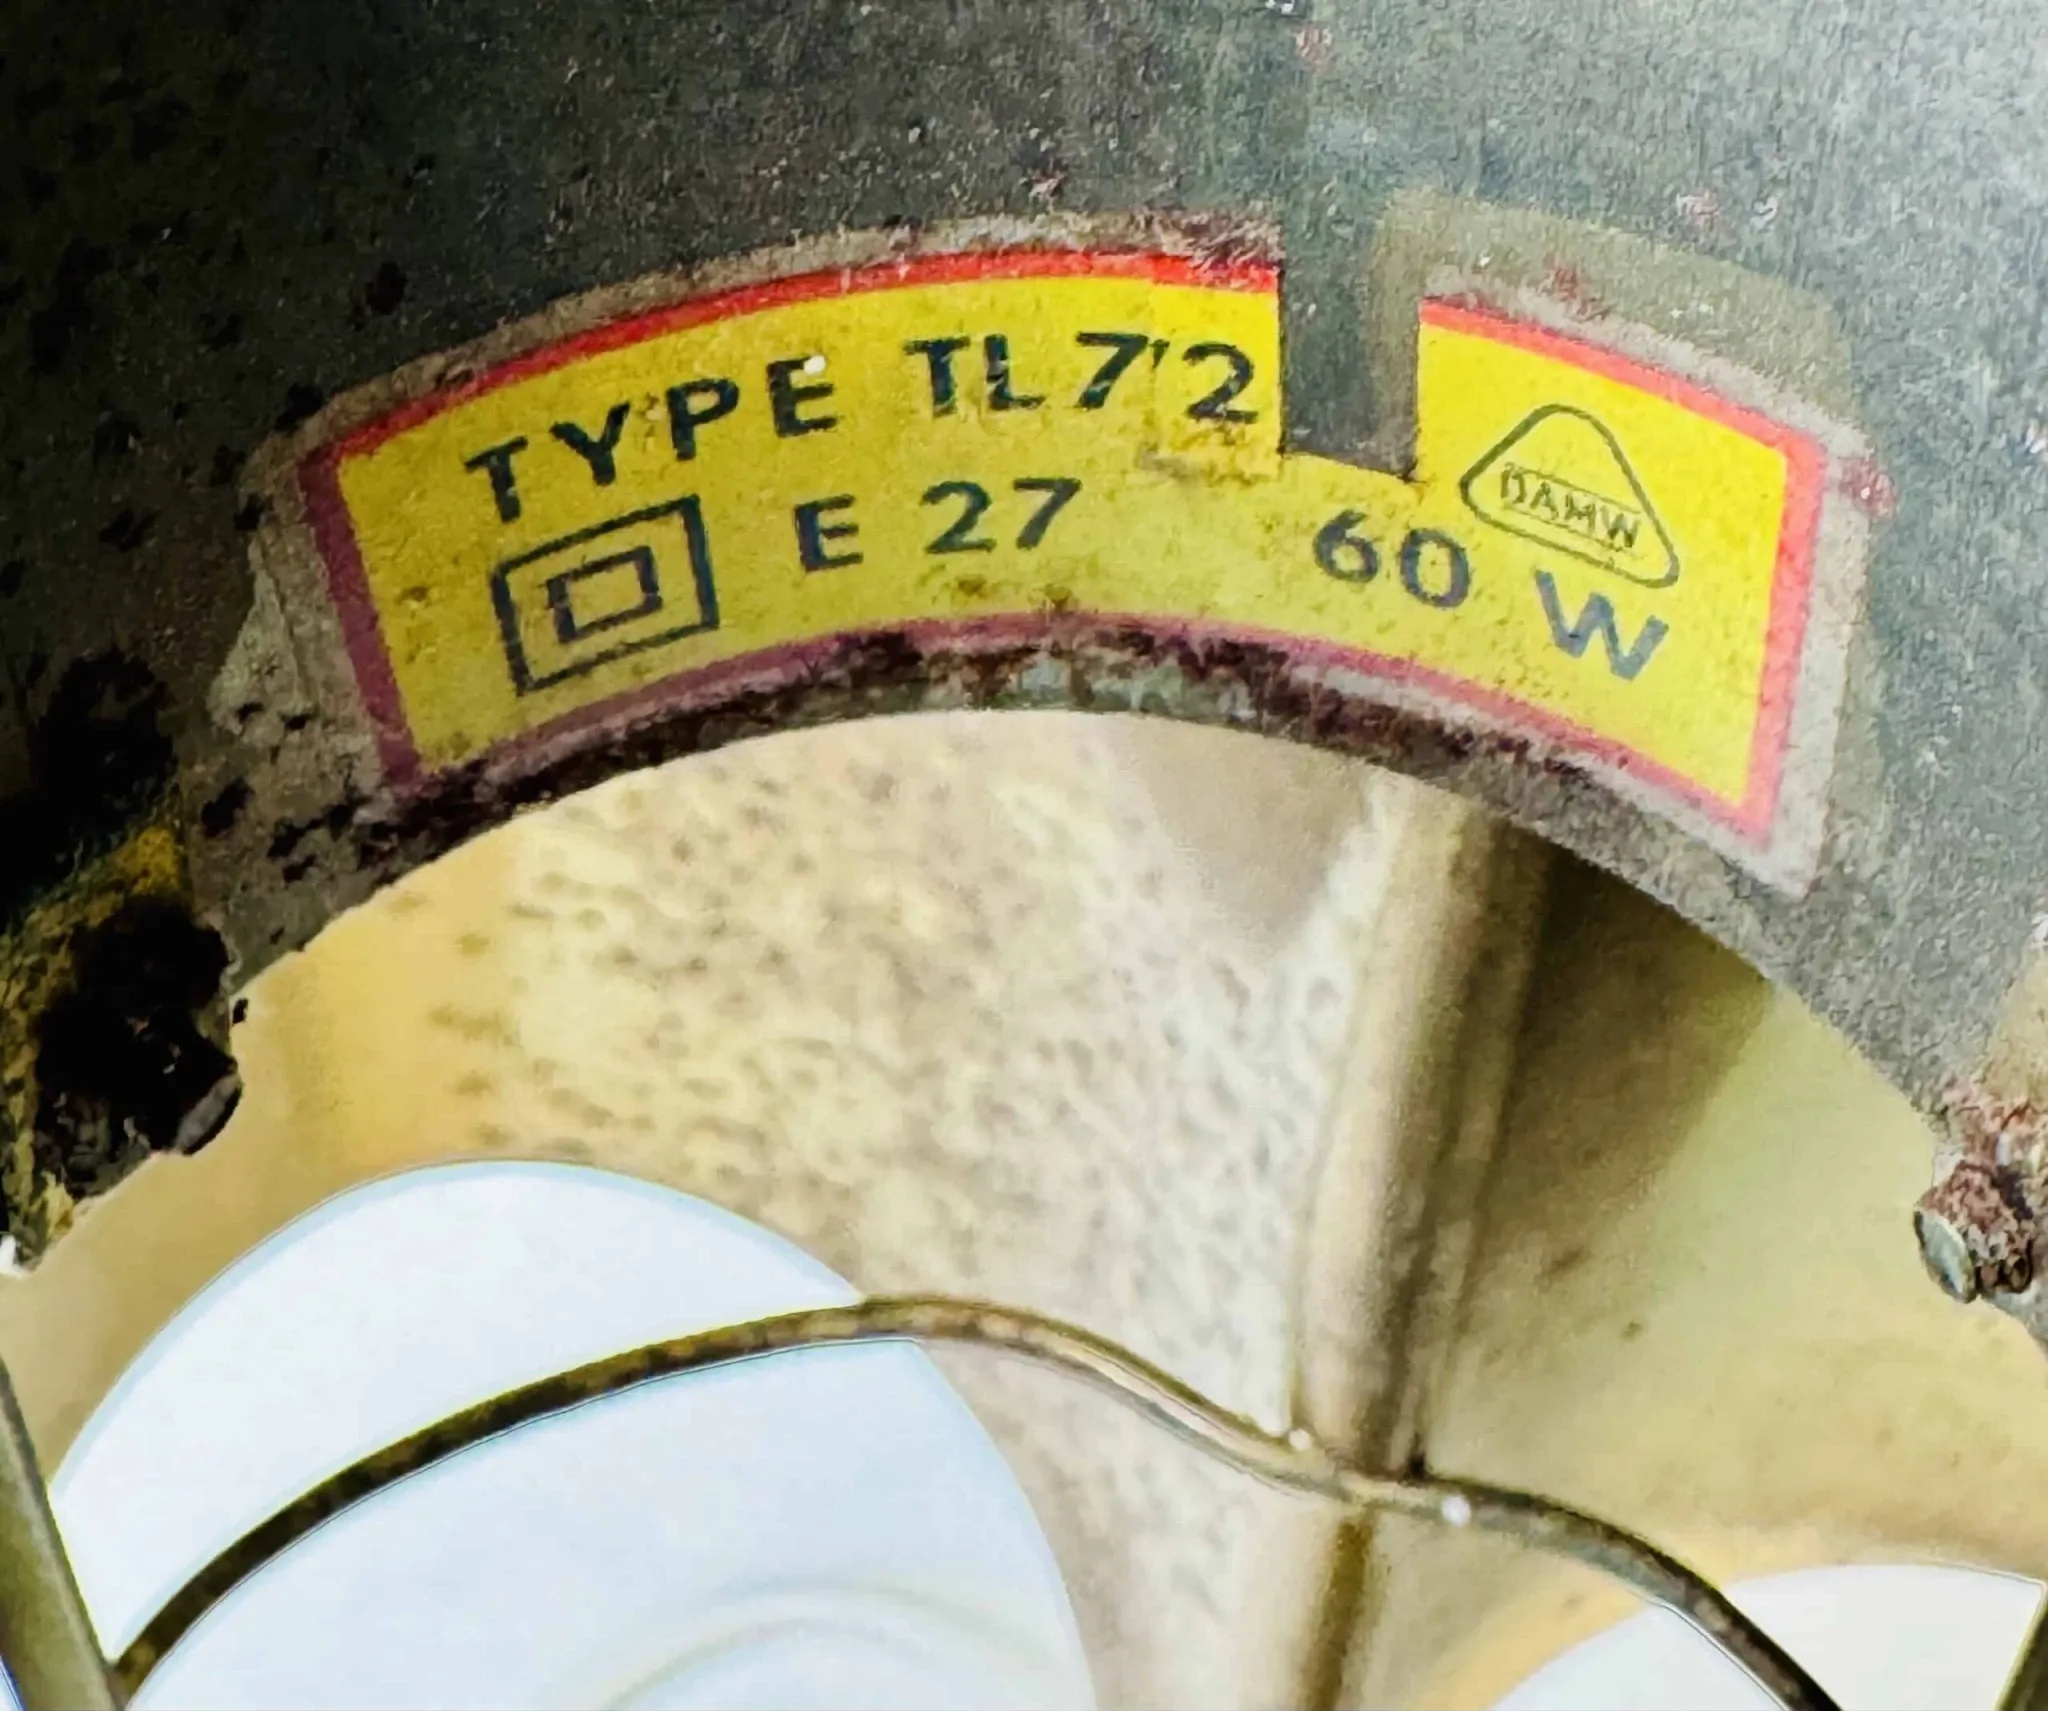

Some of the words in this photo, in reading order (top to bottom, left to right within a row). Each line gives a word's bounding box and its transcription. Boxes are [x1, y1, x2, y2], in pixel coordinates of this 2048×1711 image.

[464, 354, 838, 523] TYPE
[795, 494, 864, 573] E
[919, 477, 1083, 555] 27
[1312, 509, 1472, 609] 60
[1534, 568, 1670, 681] W
